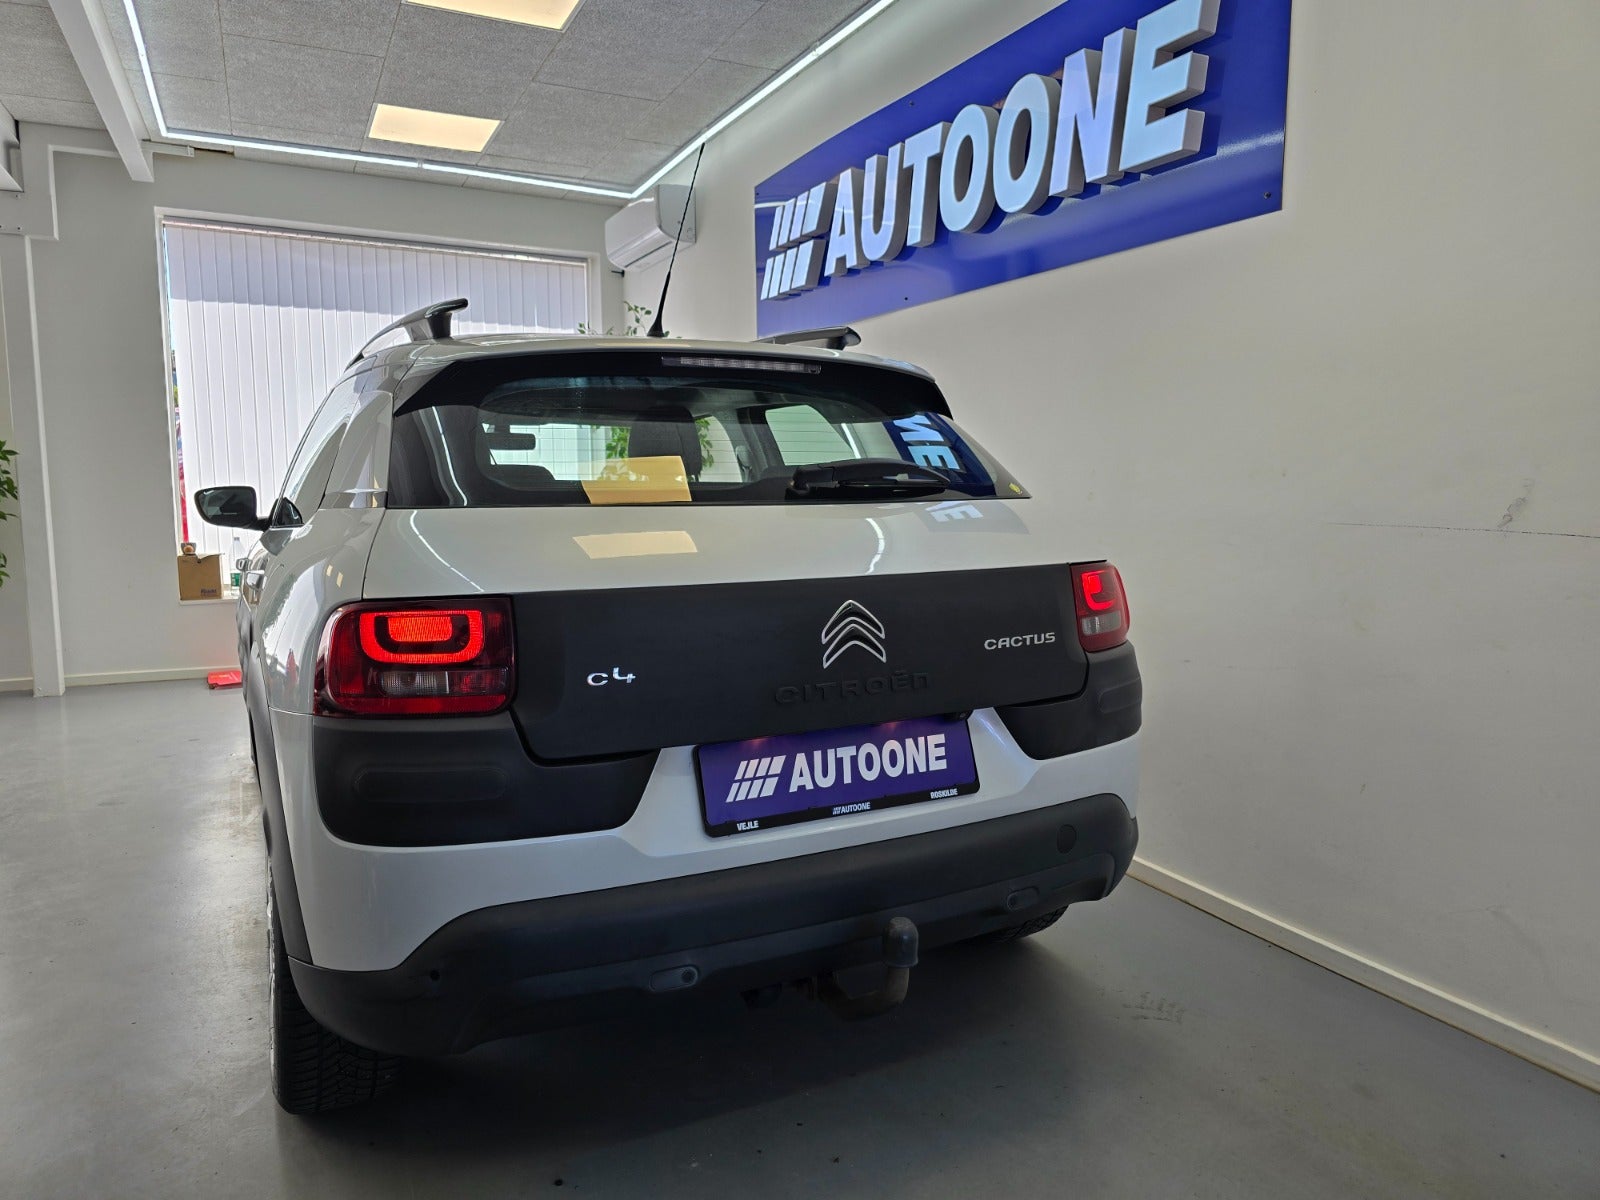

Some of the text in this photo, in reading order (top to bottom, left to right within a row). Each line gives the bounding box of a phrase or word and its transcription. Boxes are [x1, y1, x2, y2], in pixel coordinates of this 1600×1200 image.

[824, 0, 1217, 277] AUTOONE
[984, 632, 1056, 650] CACTUS
[587, 667, 636, 686] C4
[789, 734, 947, 793] AUTOONE
[930, 788, 958, 798] ROSKILDE
[840, 802, 871, 814] AUTOONE
[737, 820, 759, 831] VEJLE
